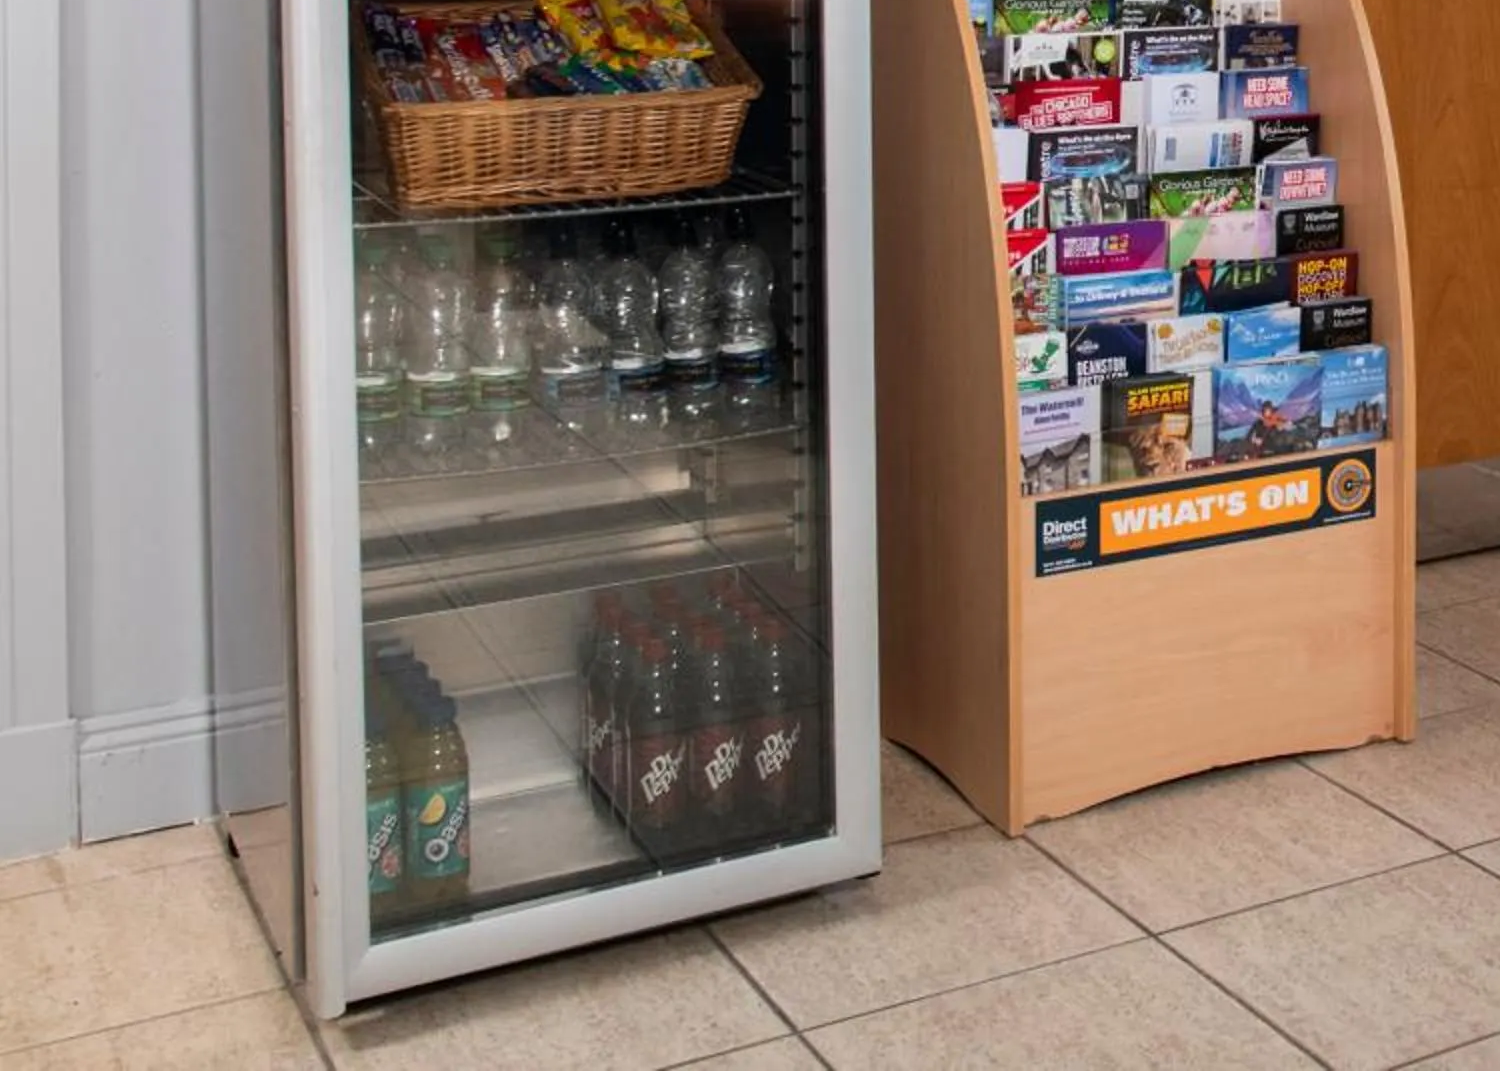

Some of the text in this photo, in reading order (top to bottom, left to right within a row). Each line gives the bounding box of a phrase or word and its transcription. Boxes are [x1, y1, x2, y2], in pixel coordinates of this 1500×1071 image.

[1298, 257, 1347, 274] HOP-ON
[1127, 389, 1190, 411] SAFARI
[1111, 480, 1310, 537] WHAT'S ON
[1043, 516, 1088, 536] Direct
[425, 795, 466, 862] Oasi
